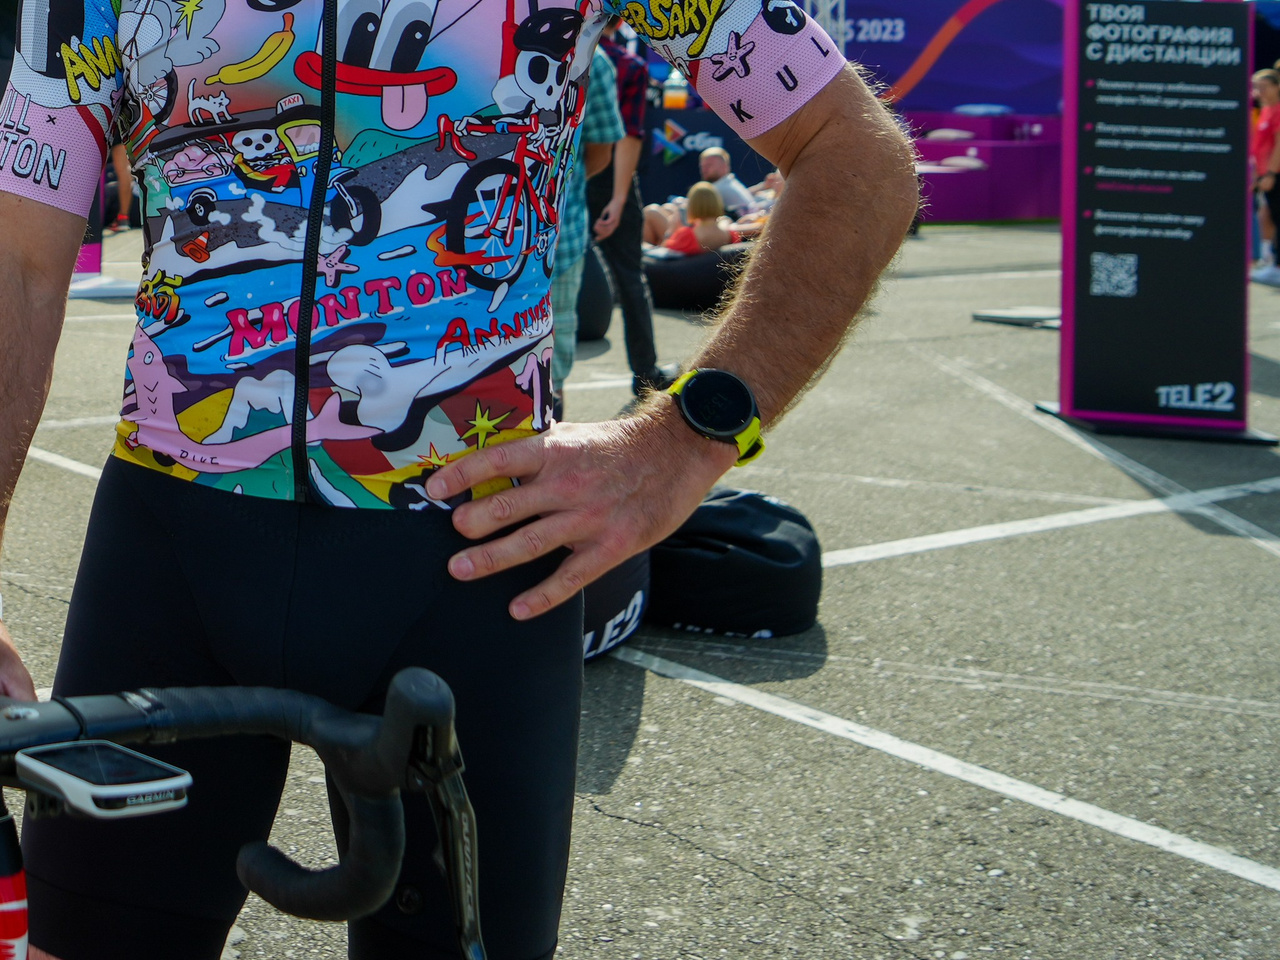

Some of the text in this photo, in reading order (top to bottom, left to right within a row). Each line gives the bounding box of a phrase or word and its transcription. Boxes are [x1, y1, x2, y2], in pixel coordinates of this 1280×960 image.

[1086, 3, 1145, 22] ТВОЯ
[856, 18, 905, 42] 2023
[1086, 23, 1234, 45] ФОТОГРАФИЯ
[1085, 43, 1242, 67] С ДИСТАНЦИИ
[282, 95, 301, 107] TAXI
[1155, 381, 1236, 411] TELE2
[126, 788, 175, 805] GARMIN
